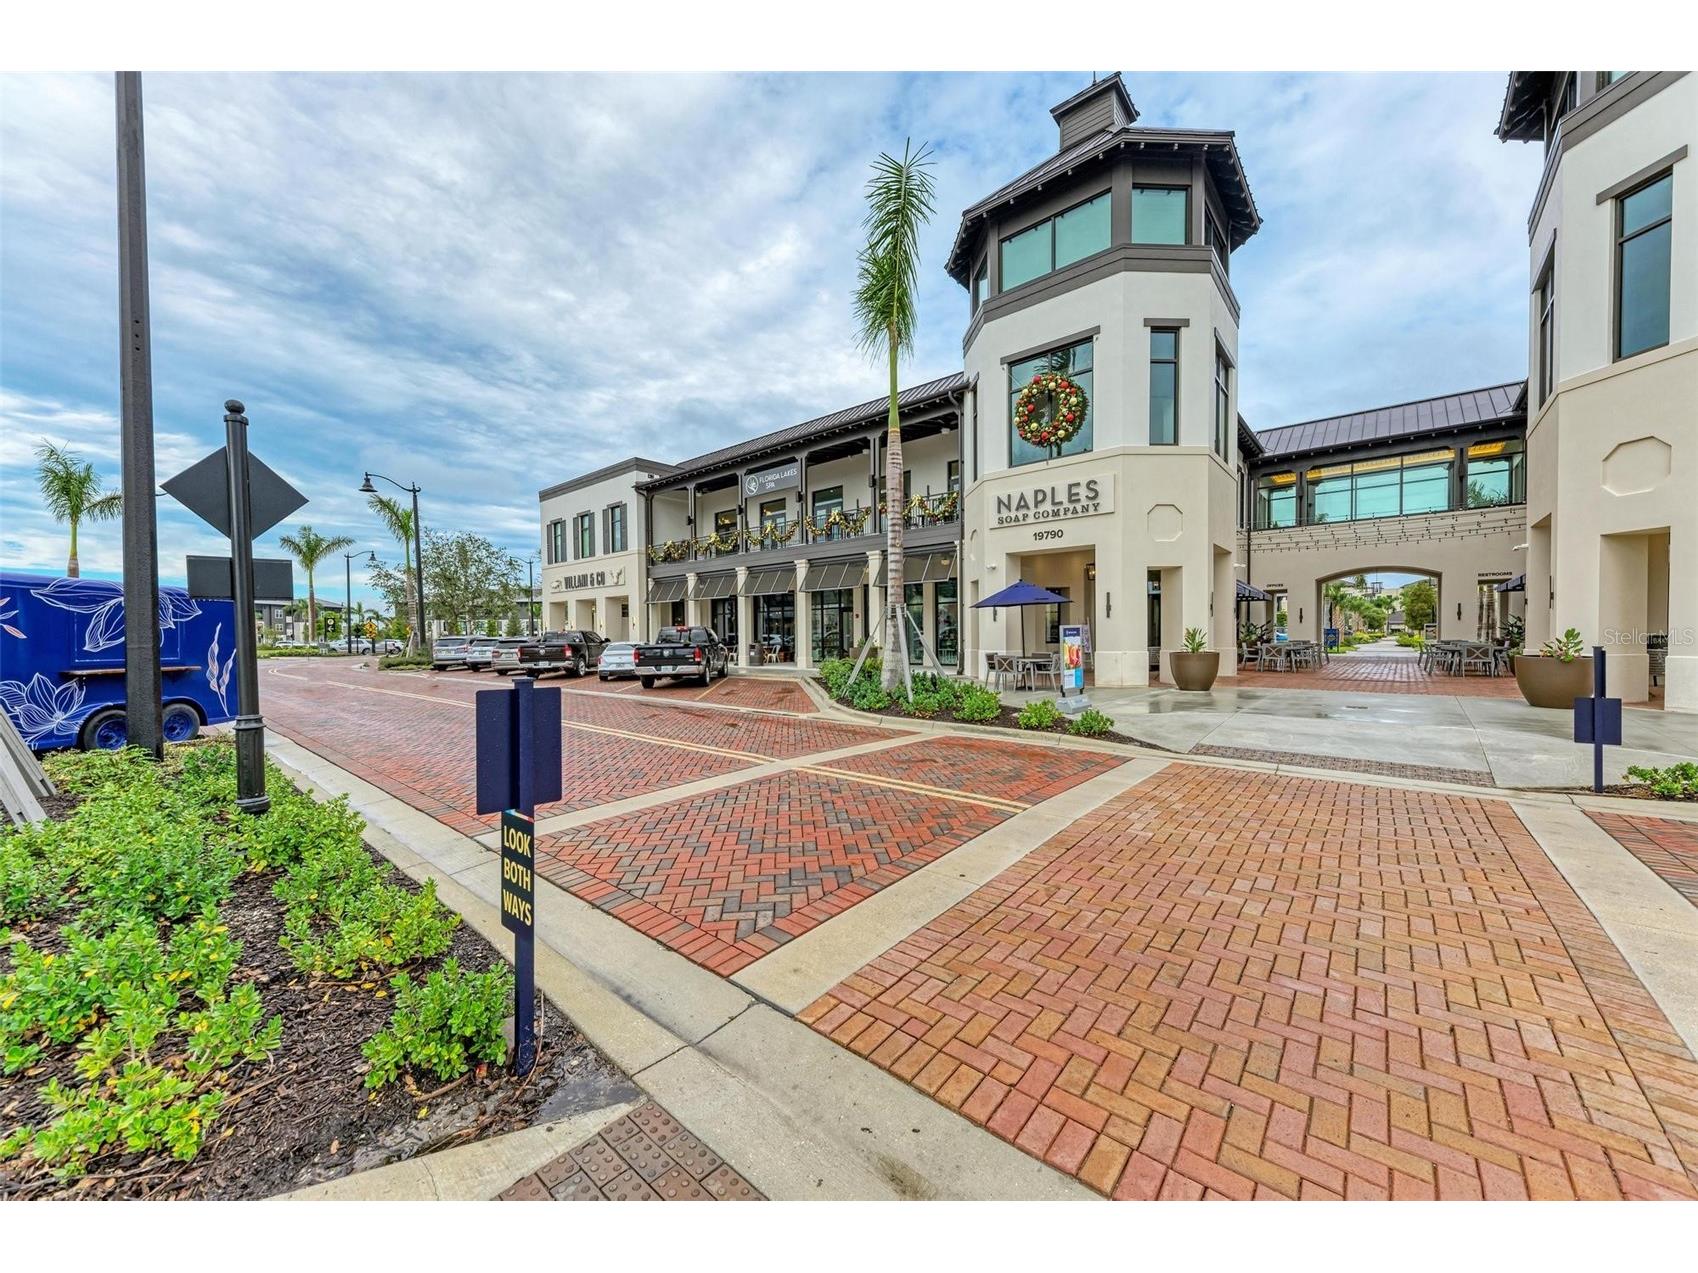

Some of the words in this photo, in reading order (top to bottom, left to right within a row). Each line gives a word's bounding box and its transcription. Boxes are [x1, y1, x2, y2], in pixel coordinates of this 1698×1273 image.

[760, 473, 780, 483] FLORIDA
[780, 468, 797, 479] LAKES
[996, 479, 1100, 515] NAPLES
[997, 512, 1029, 525] SOAP
[1033, 502, 1100, 520] COMPANY
[1032, 529, 1064, 541] 19790
[589, 572, 595, 587] &
[596, 571, 606, 586] CO
[503, 824, 532, 859] LOOK
[503, 856, 532, 893] BOTH
[502, 888, 533, 927] WAYS
